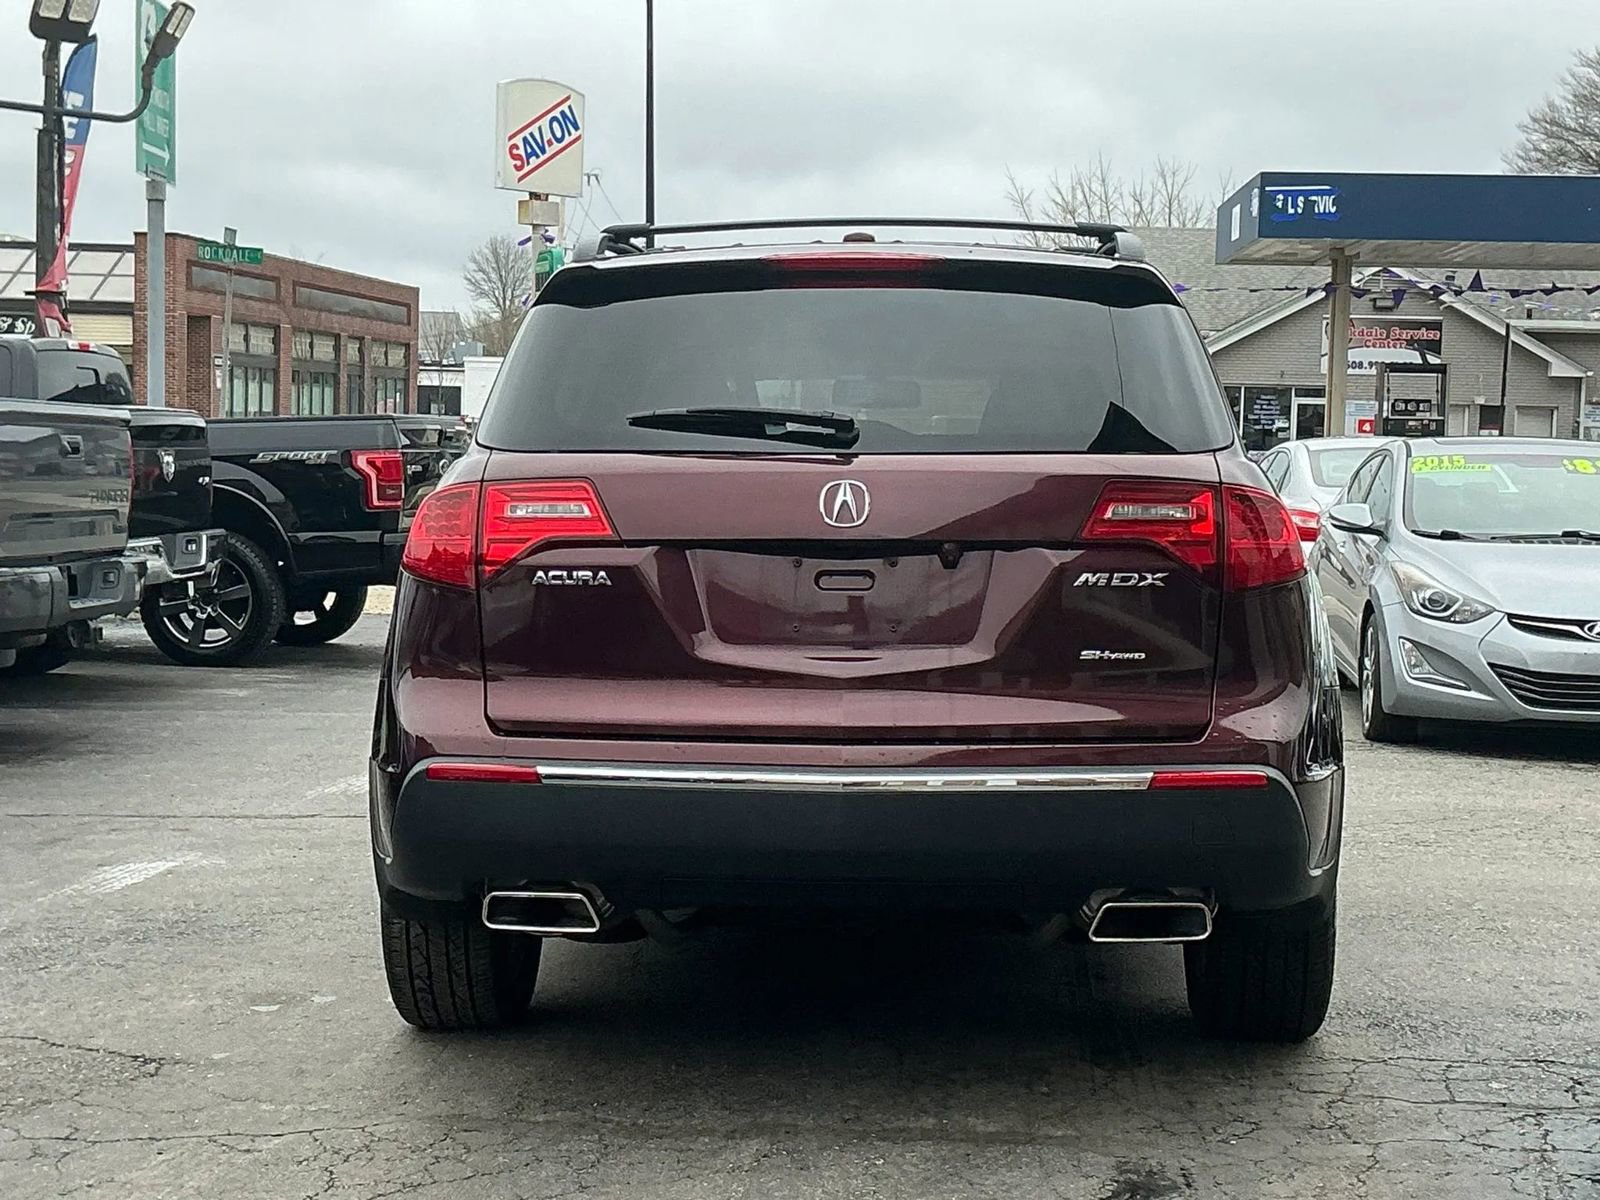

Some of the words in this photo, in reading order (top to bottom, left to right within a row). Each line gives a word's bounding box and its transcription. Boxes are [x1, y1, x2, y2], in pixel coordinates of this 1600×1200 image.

[198, 246, 250, 262] ROCKDALE
[1349, 326, 1386, 338] kdale
[1390, 327, 1440, 339] Service
[1363, 339, 1407, 350] Center
[248, 450, 338, 464] SPORT
[1411, 455, 1466, 470] 2015
[532, 570, 613, 586] ACURA
[1073, 572, 1170, 587] MDX
